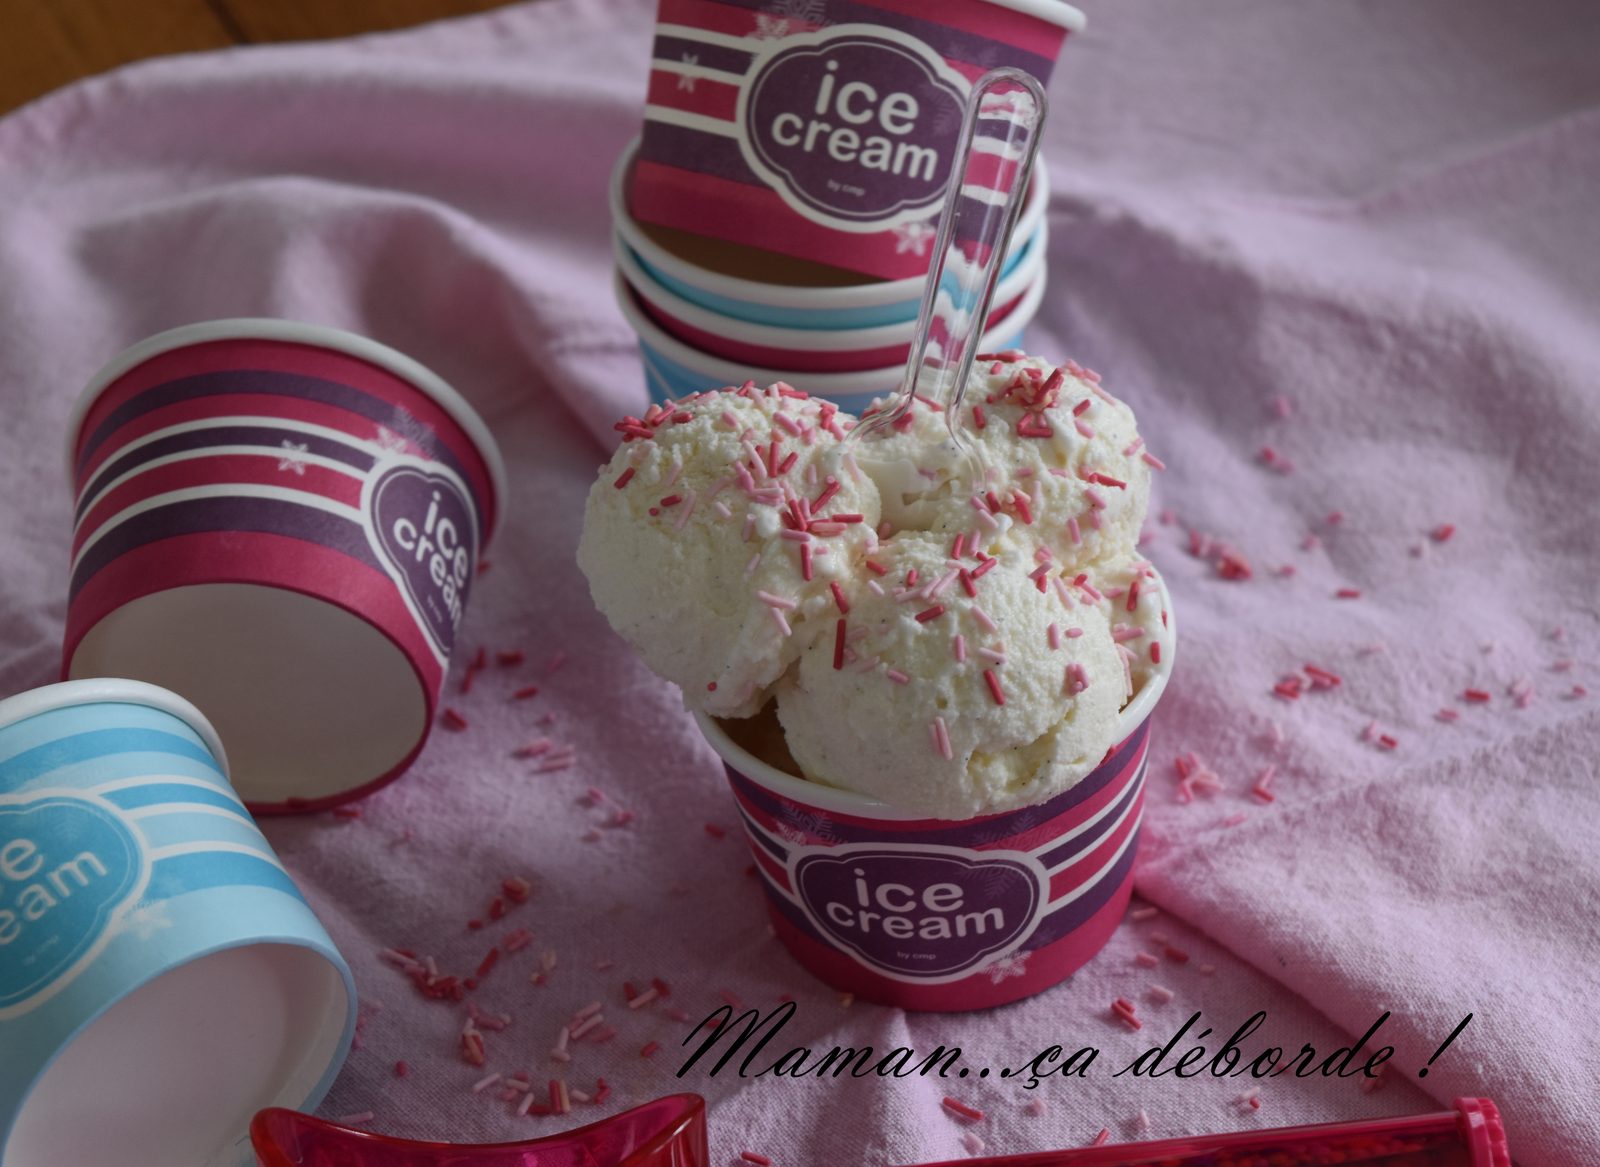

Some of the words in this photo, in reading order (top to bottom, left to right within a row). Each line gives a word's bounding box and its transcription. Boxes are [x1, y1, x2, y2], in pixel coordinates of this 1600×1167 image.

[814, 60, 920, 135] ice
[771, 112, 938, 182] cream
[424, 490, 469, 588] ice
[0, 851, 108, 945] eam
[826, 901, 1004, 940] cream
[854, 868, 964, 913] ice
